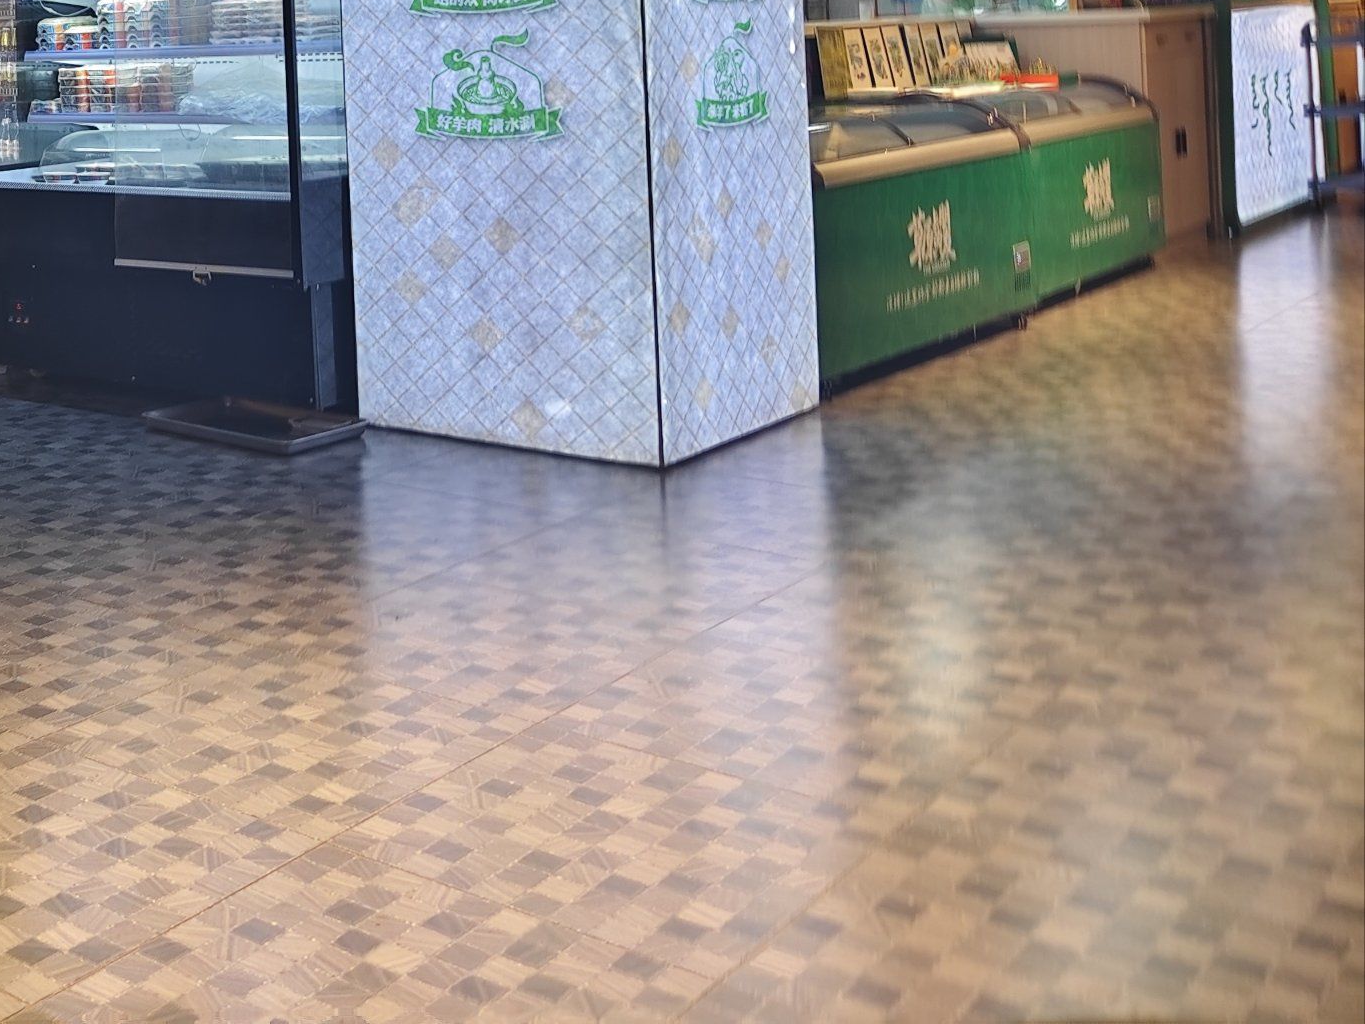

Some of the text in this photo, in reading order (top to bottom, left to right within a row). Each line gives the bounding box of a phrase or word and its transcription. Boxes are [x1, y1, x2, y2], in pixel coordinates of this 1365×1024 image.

[437, 114, 536, 133] 好羊肉 清水涮
